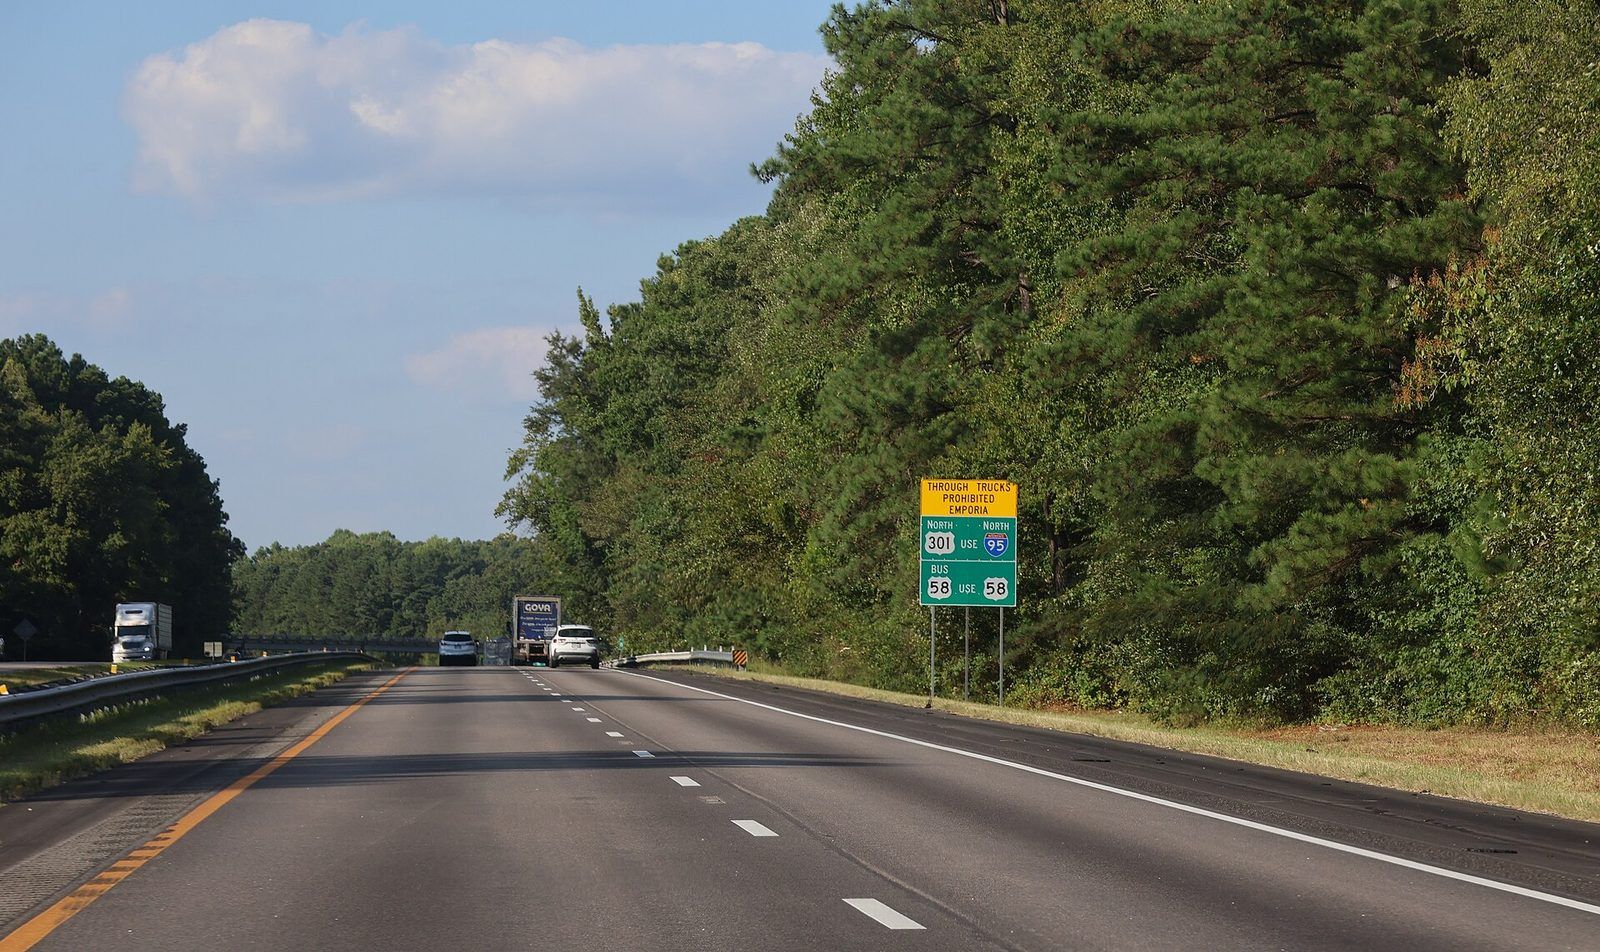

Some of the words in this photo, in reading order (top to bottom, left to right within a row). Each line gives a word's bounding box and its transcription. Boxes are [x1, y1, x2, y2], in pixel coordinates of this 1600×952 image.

[928, 482, 968, 492] THROUGH
[977, 483, 1011, 492] TRUCKS
[943, 494, 995, 503] PROHIBITED
[949, 506, 988, 514] EMPORIA
[927, 520, 953, 529] NORTH
[983, 521, 1009, 531] NORTH
[928, 536, 950, 550] 301
[961, 539, 977, 549] USE
[987, 540, 1005, 551] 95
[931, 565, 948, 574] BUS
[930, 581, 949, 594] 58
[958, 584, 976, 593] USE
[986, 582, 1006, 595] 58
[525, 603, 551, 612] GOYA
